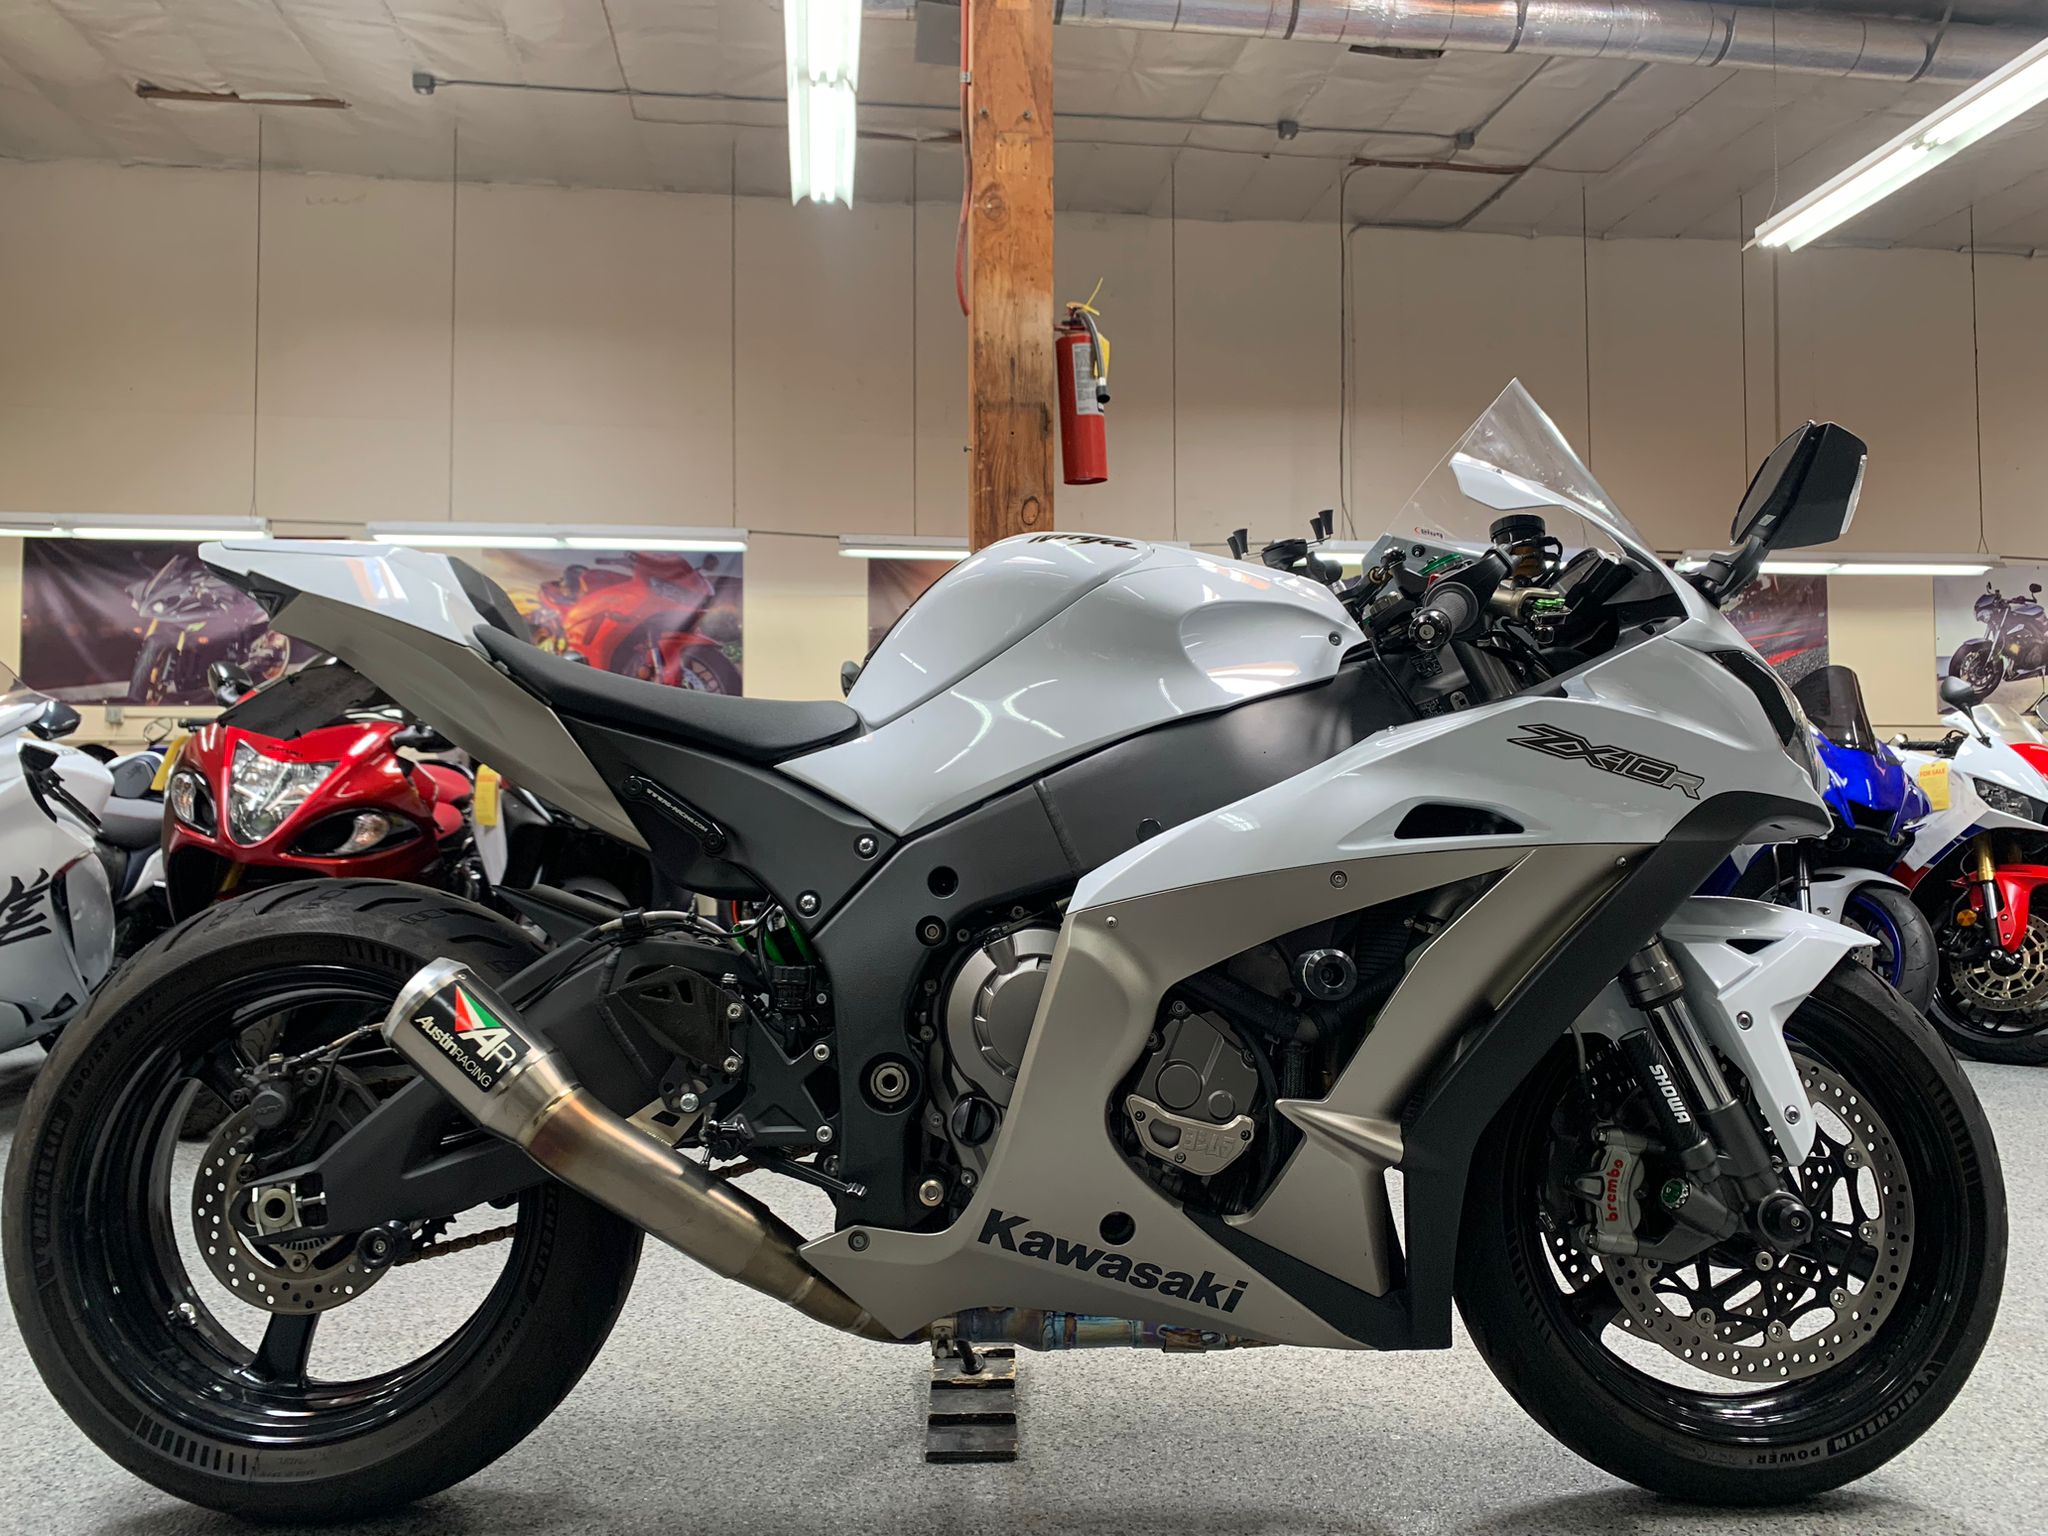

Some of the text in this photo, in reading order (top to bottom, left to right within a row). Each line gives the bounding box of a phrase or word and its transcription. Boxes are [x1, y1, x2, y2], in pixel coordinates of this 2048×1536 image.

[1648, 1063, 1691, 1124] SHOWA
[1605, 1158, 1624, 1222] brembo
[977, 1207, 1249, 1313] Kawasaki
[1833, 1385, 1920, 1451] MICHELIN
[1756, 1446, 1820, 1464] POWER
